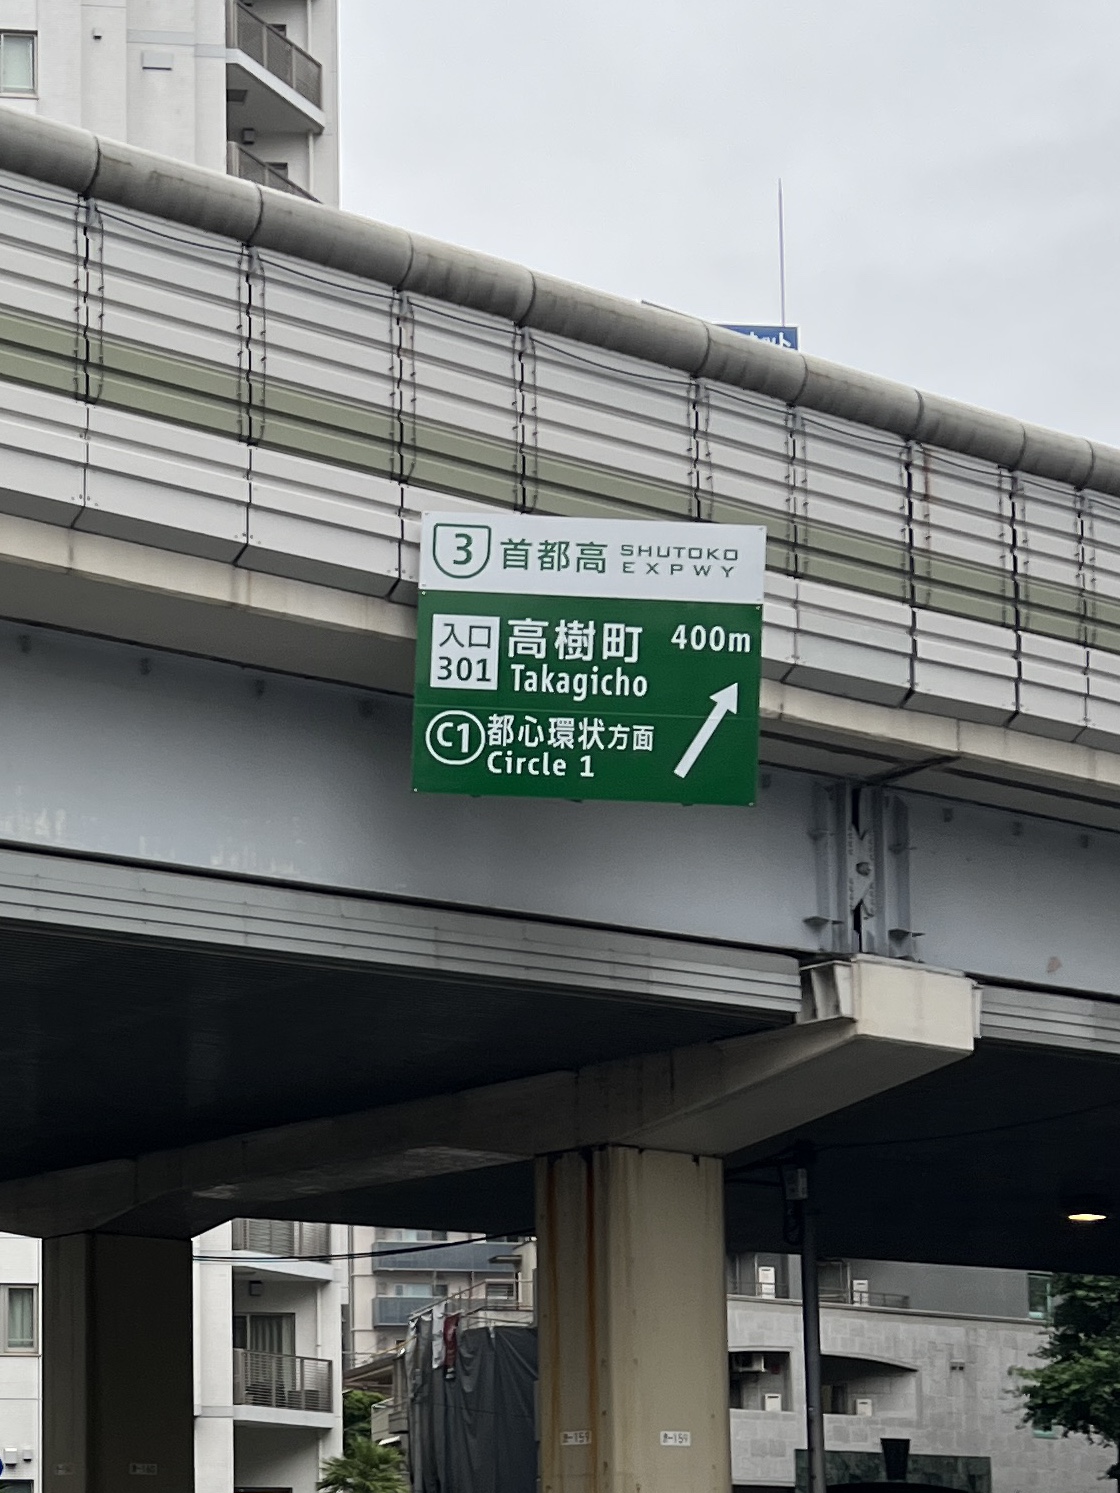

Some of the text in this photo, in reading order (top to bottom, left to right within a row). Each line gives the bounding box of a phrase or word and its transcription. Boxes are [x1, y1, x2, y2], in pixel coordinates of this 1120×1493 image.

[452, 532, 473, 566] 3
[499, 537, 608, 574] 首都高
[620, 543, 739, 562] SHUTOKO
[438, 623, 492, 648] 入口
[506, 617, 644, 664] 高樹町
[670, 624, 751, 653] 400m
[436, 655, 492, 683] 301
[511, 663, 648, 701] Takagicho
[435, 721, 470, 754] C1
[487, 713, 655, 752] 都心環状方面
[486, 750, 595, 778] Circle 1
